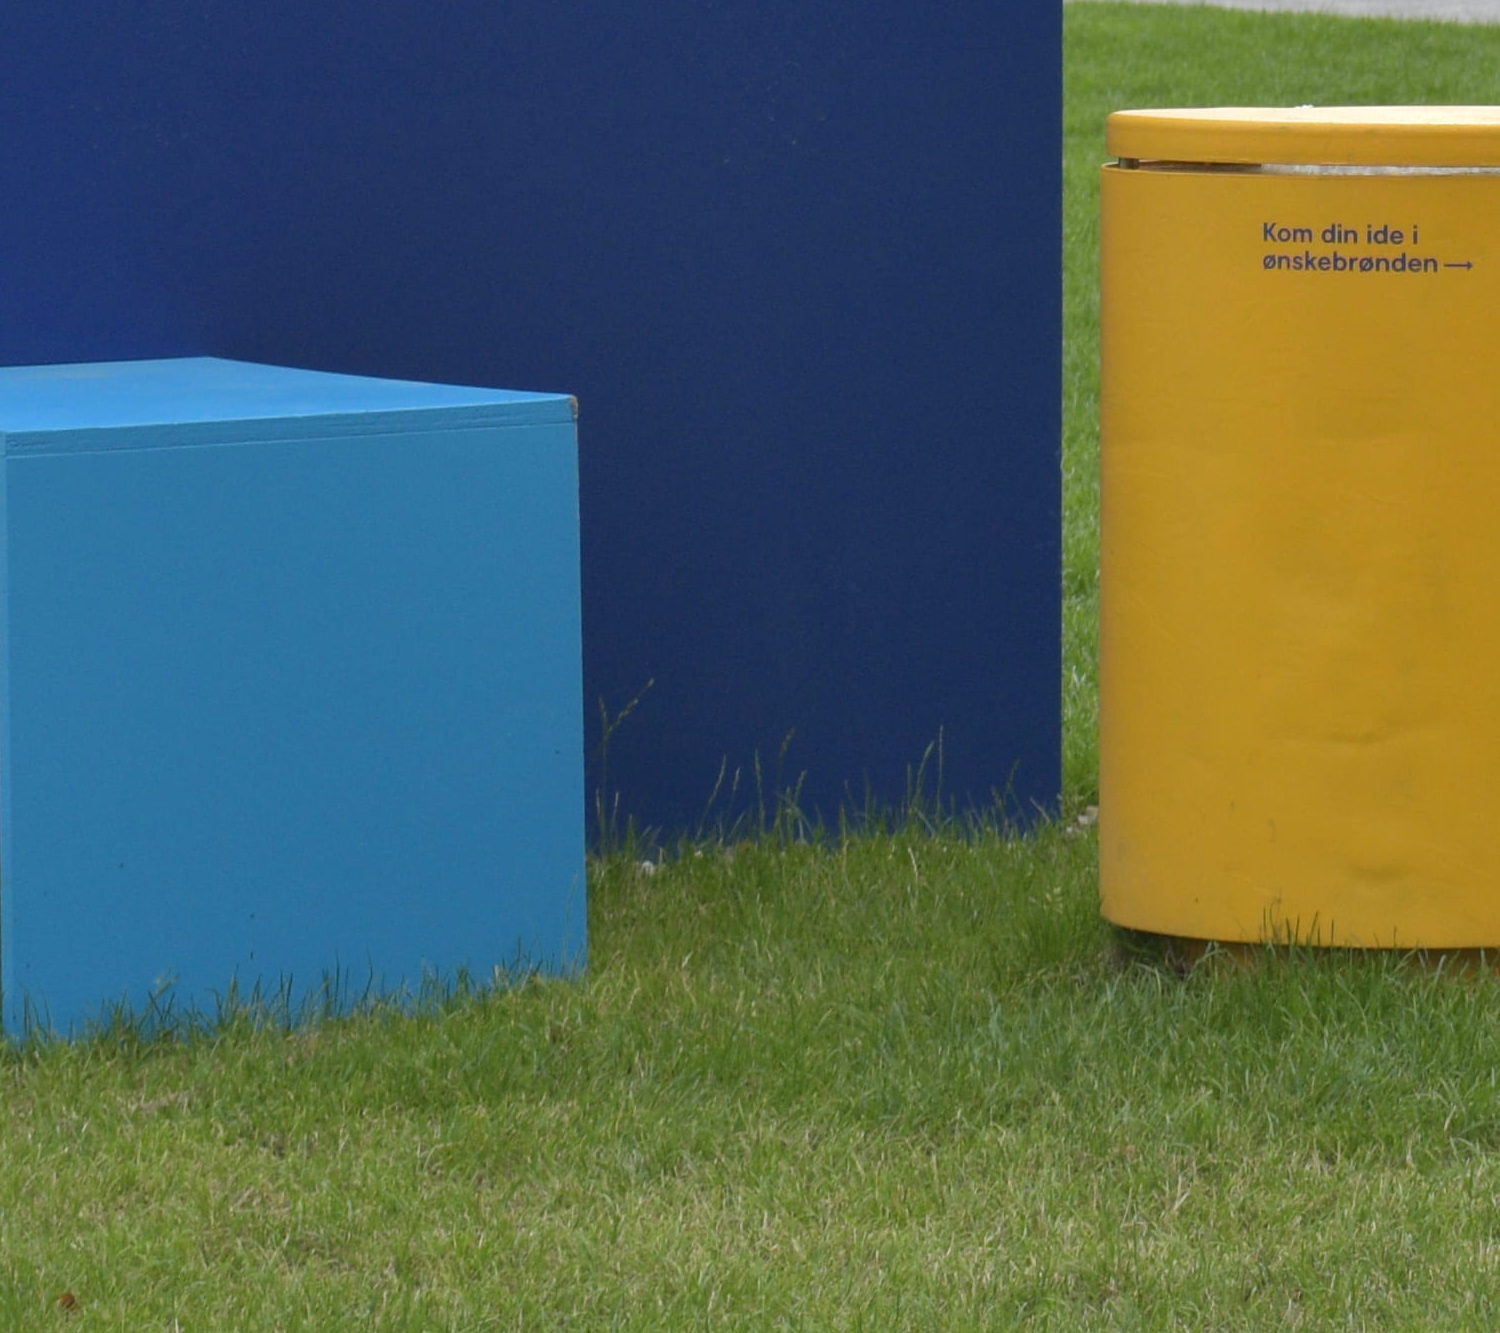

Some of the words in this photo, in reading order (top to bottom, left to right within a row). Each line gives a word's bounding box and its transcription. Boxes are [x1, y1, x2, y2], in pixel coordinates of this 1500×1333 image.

[1263, 222, 1313, 243] Kom
[1321, 223, 1358, 244] din
[1366, 224, 1404, 245] ide
[1412, 224, 1419, 245] i
[1263, 250, 1438, 273] ønskebrønden
